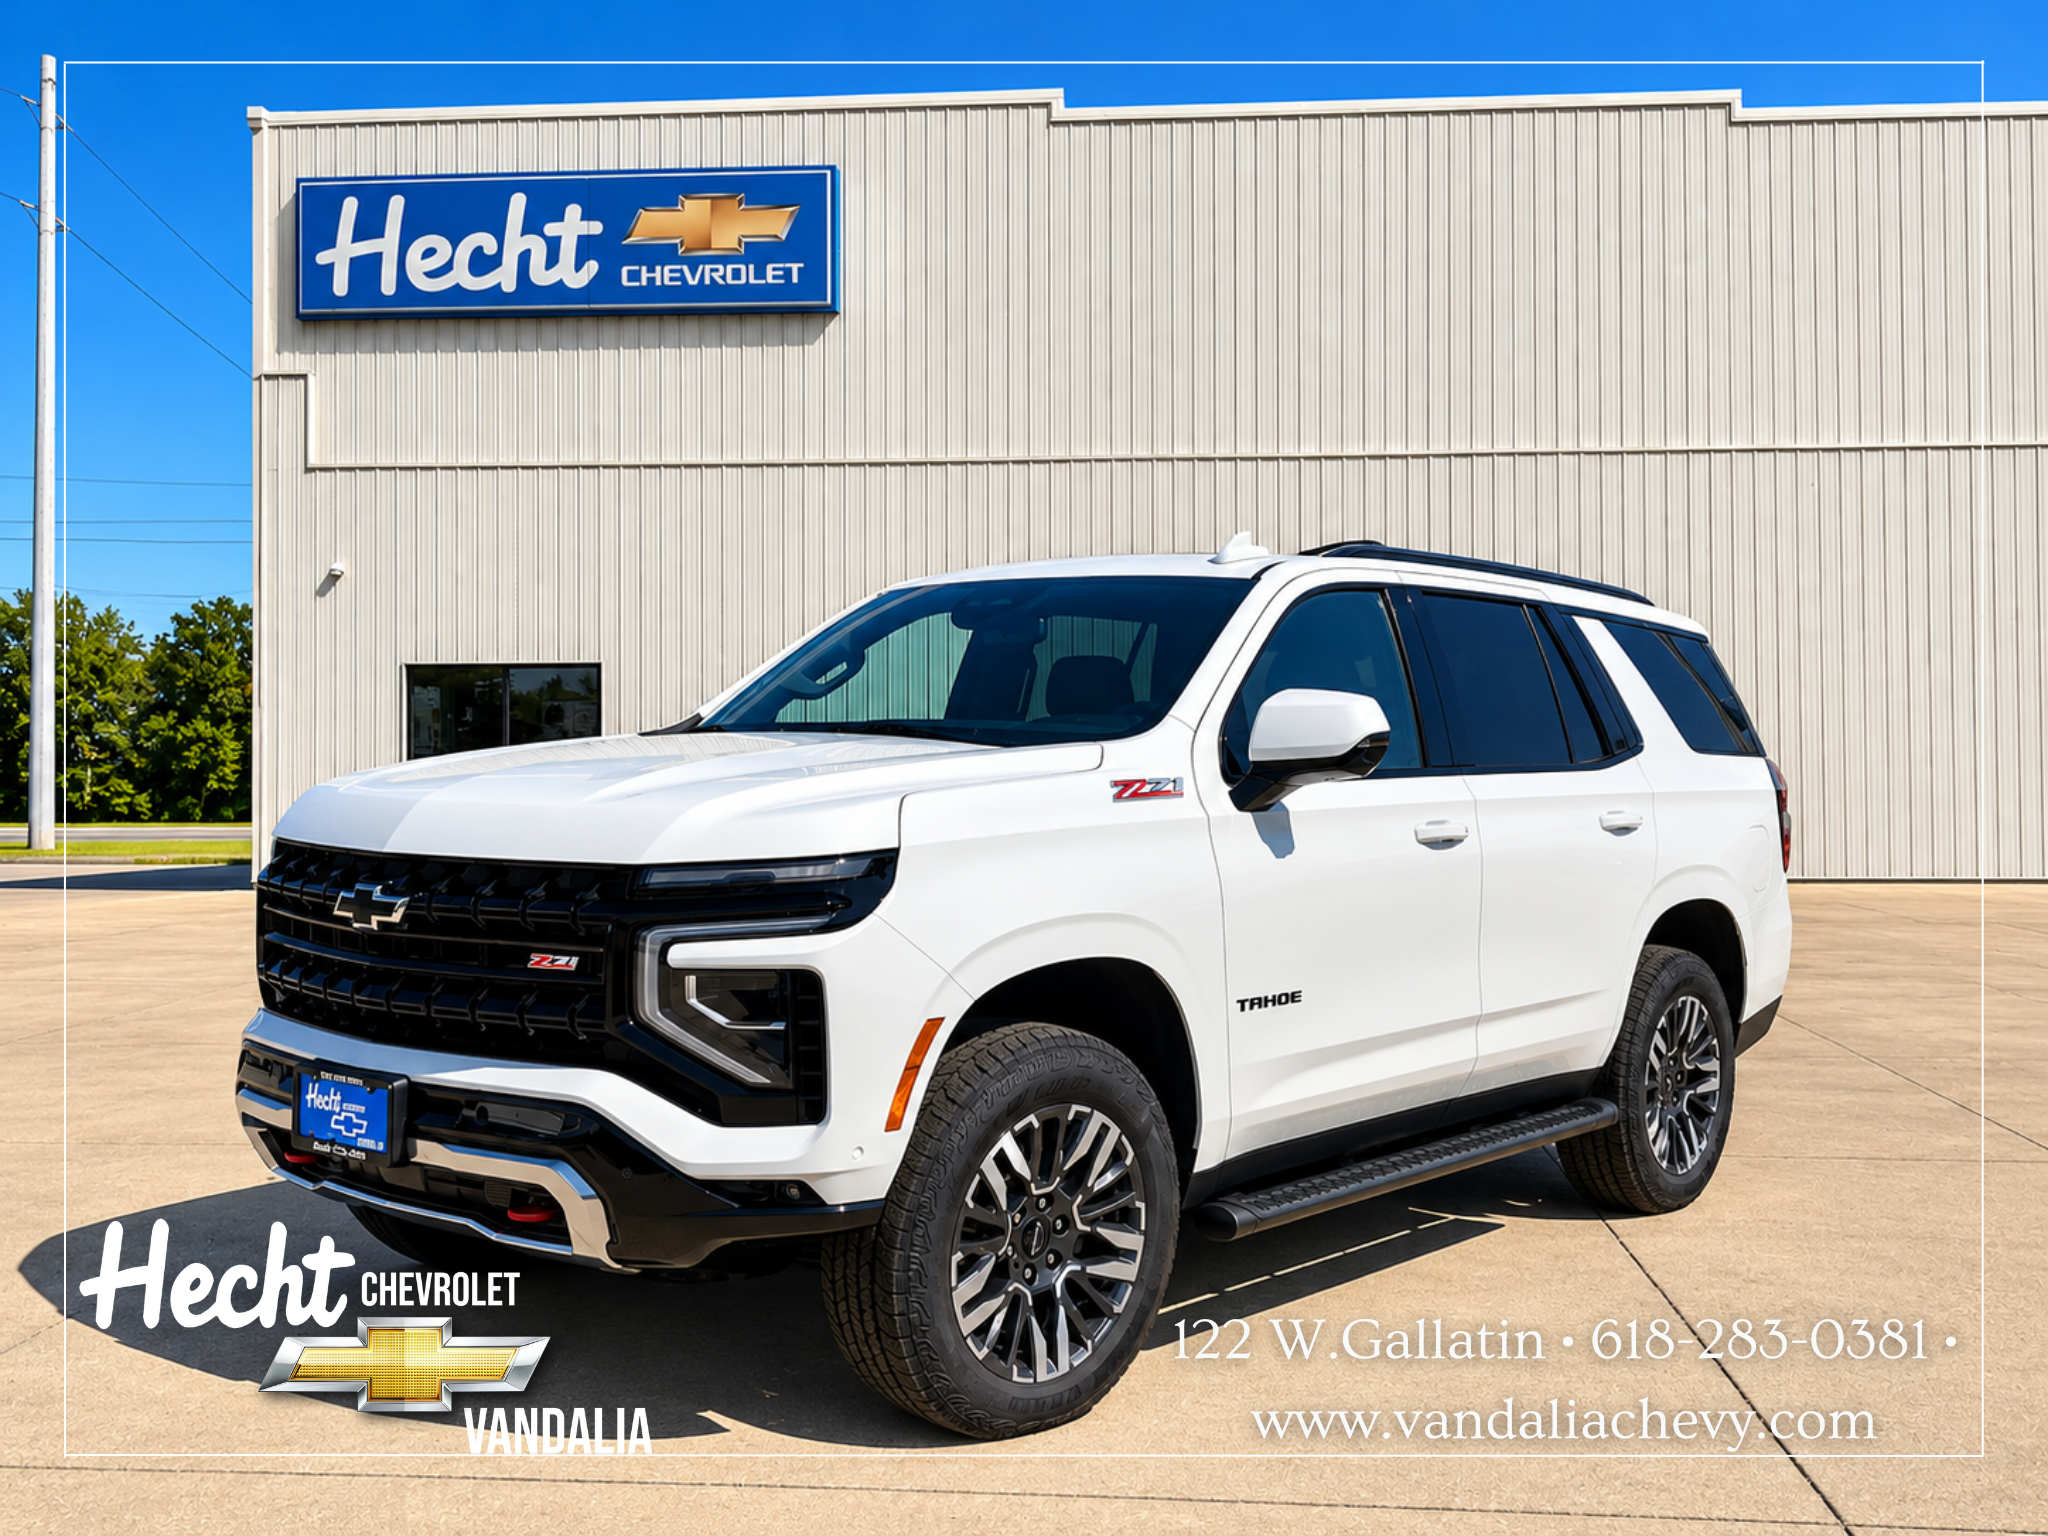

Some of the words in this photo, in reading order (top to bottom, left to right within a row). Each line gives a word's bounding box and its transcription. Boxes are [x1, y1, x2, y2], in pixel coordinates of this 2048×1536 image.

[315, 192, 603, 297] Hecht
[621, 262, 804, 287] CHEVROLET
[1236, 989, 1303, 1012] TAHOE
